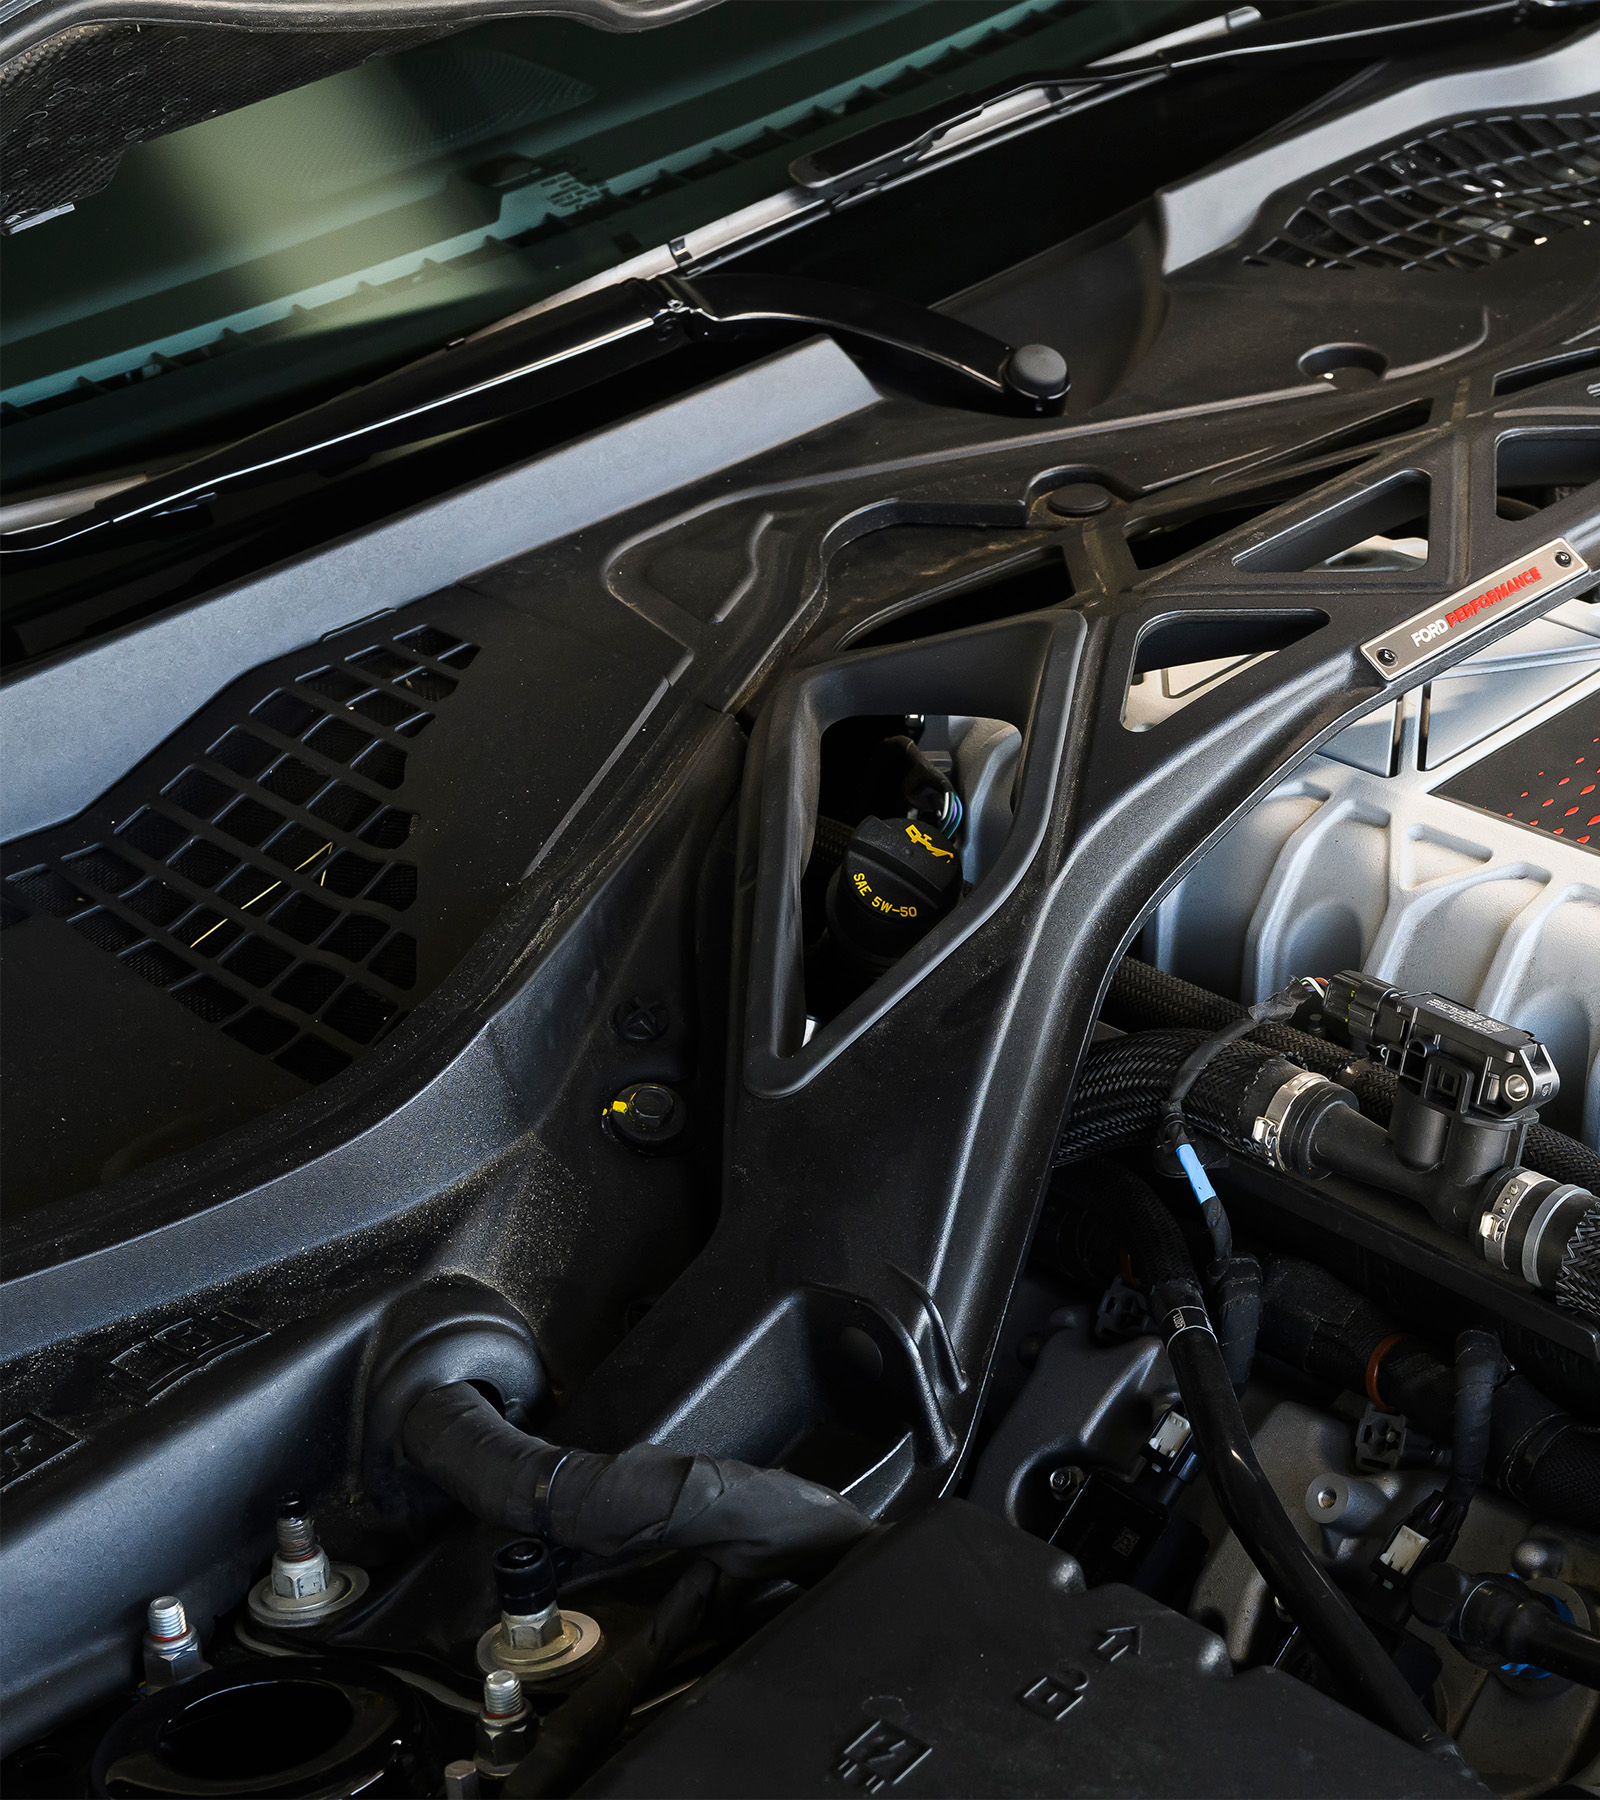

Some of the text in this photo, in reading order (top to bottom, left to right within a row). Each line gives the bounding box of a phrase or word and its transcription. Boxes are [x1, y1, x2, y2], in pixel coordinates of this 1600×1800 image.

[1411, 566, 1543, 648] FORD PERFORMANCE
[853, 872, 918, 918] SAE 5W-50
